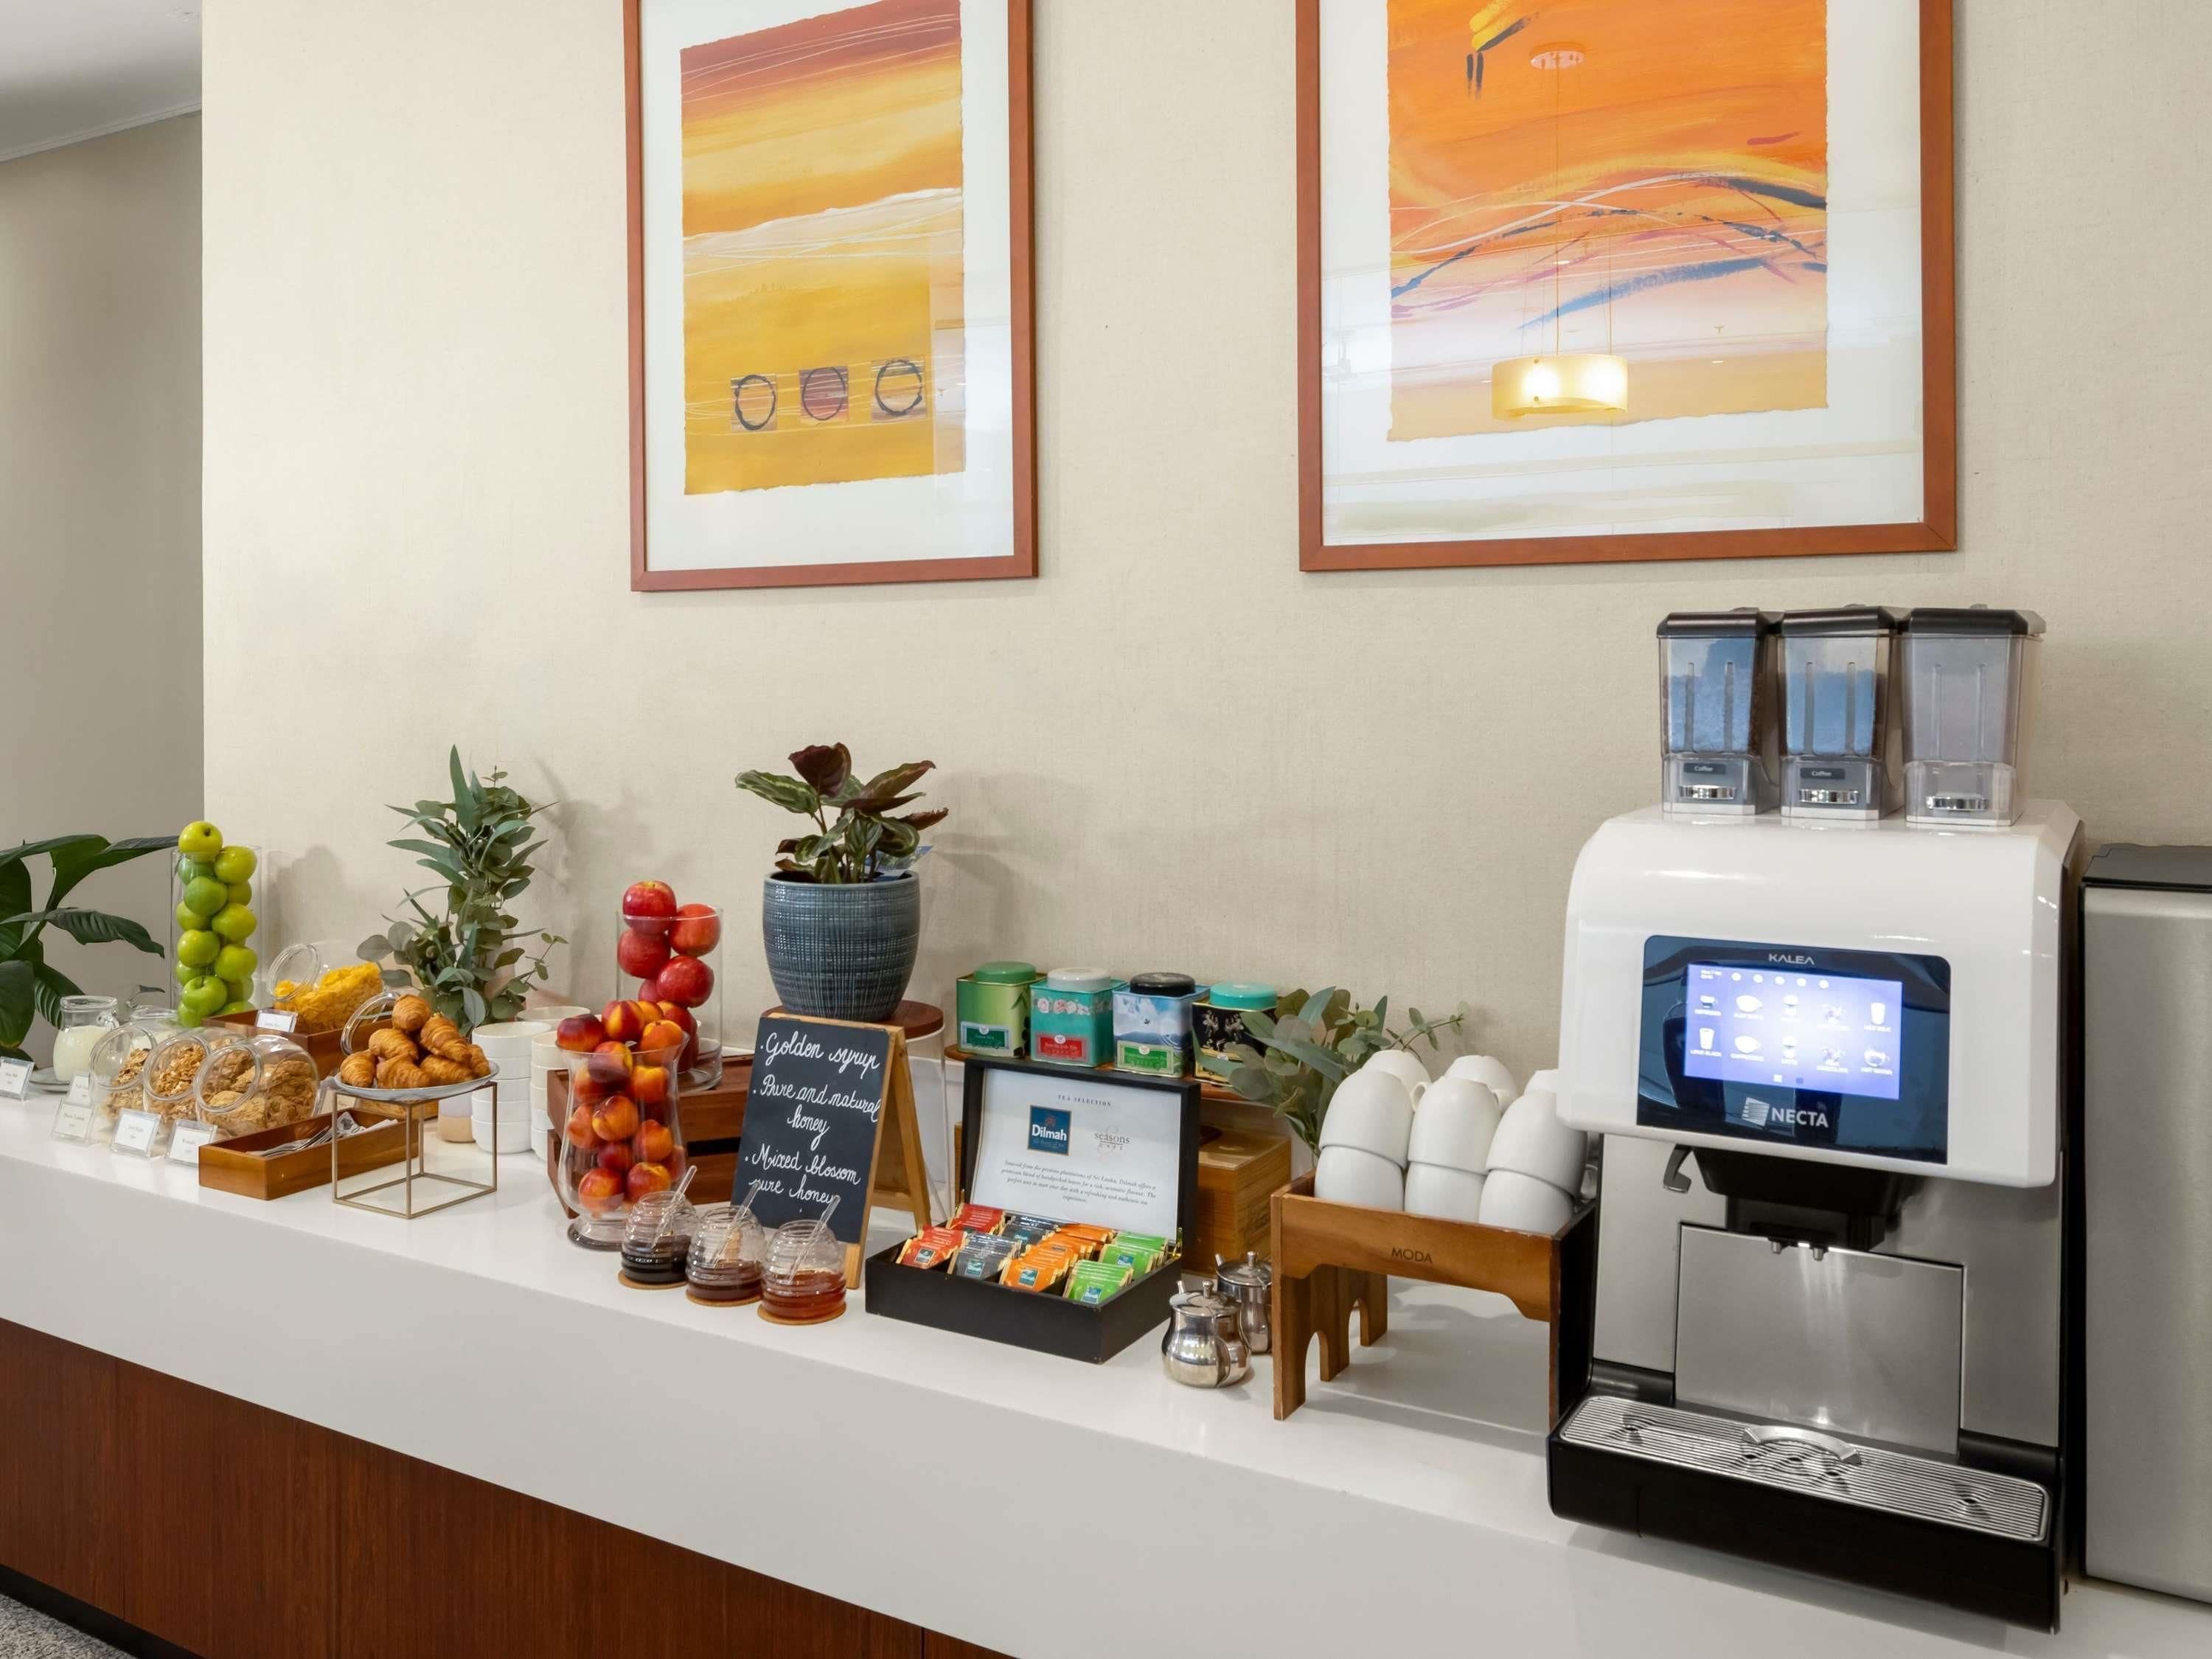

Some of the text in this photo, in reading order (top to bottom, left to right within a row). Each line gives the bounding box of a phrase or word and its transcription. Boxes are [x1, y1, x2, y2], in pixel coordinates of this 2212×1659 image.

[1769, 953, 1815, 965] KALEA
[765, 1031, 880, 1079] Golden syrup
[760, 1074, 882, 1122] Pure and natural
[1074, 1097, 1111, 1107] SELECTION
[1772, 1107, 1829, 1127] NECTA
[787, 1105, 830, 1151] honey
[1032, 1124, 1067, 1141] Dilmah
[1094, 1133, 1130, 1144] seasons
[752, 1144, 861, 1186] Mixed blossom
[1392, 1248, 1433, 1263] MODA
